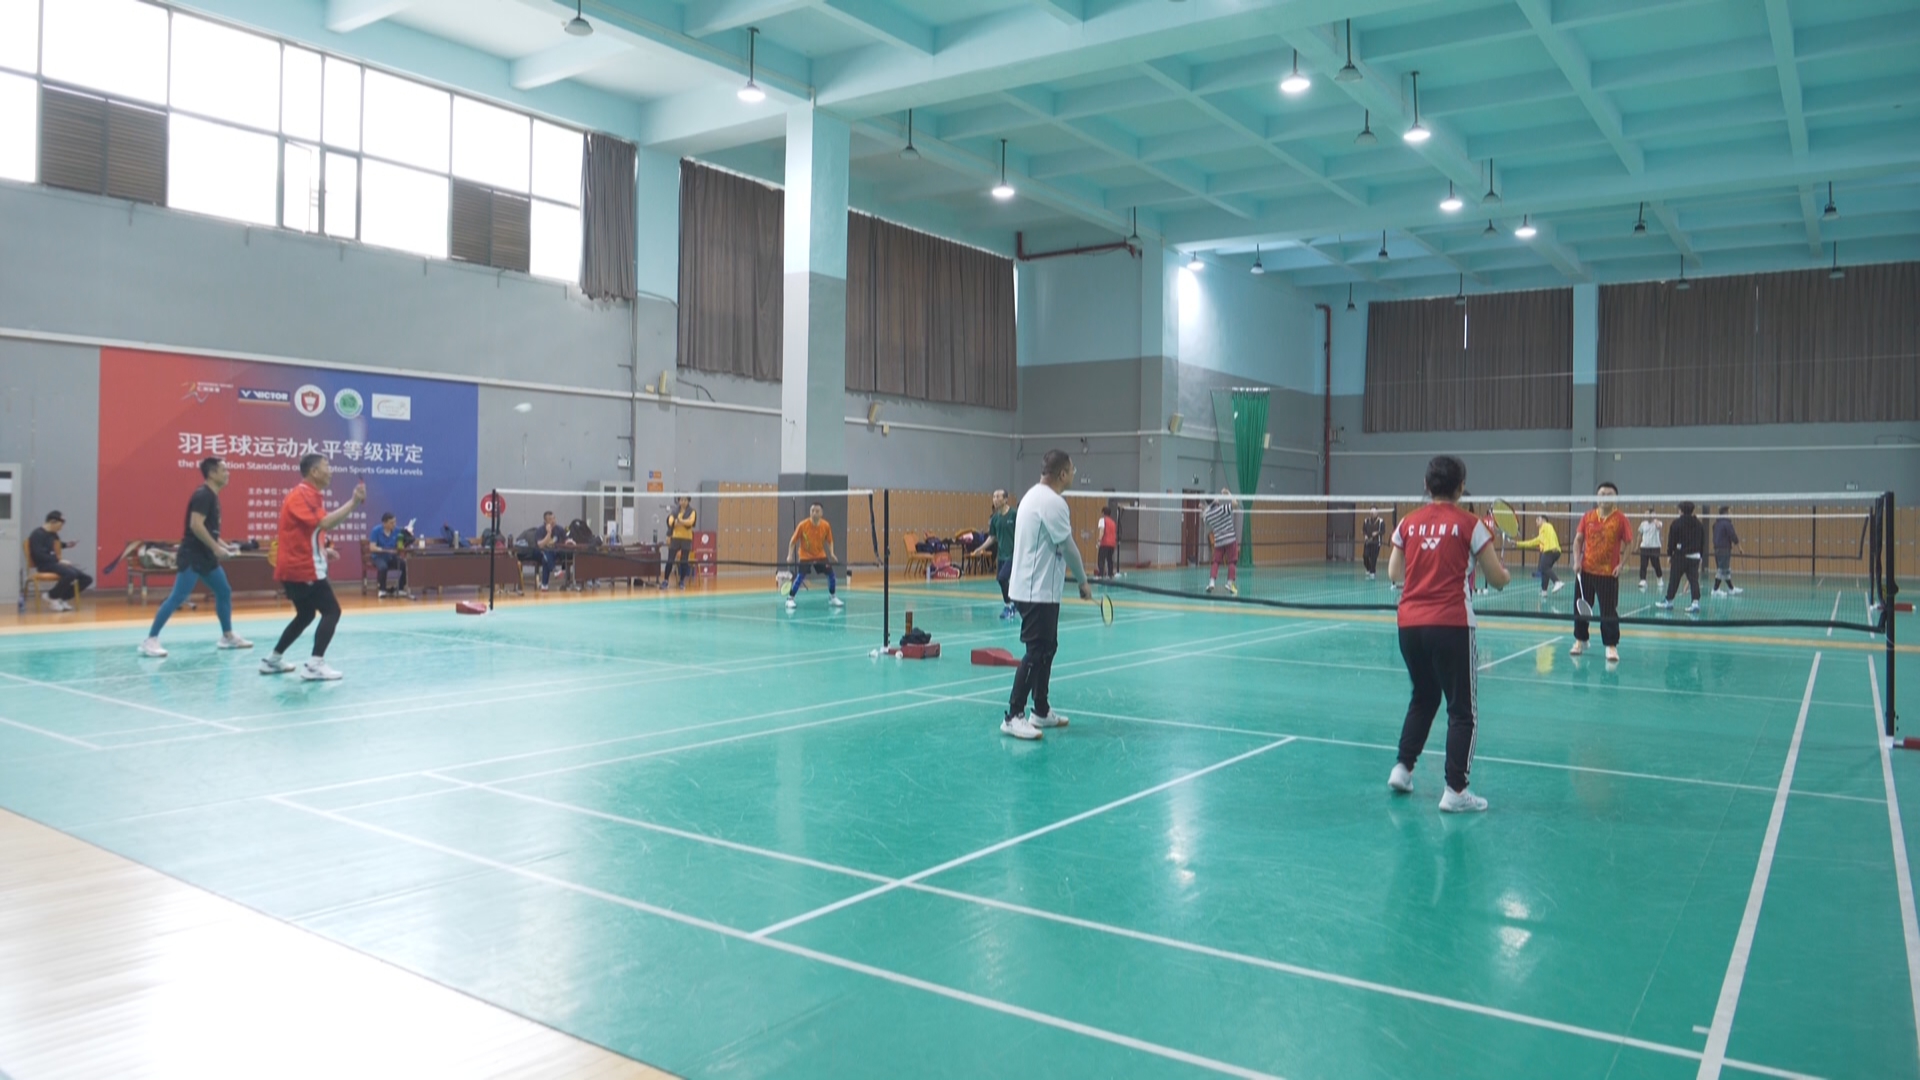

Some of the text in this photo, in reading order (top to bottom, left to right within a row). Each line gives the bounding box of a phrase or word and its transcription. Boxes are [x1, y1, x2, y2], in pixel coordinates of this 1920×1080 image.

[253, 390, 288, 401] VICTOR
[178, 432, 423, 464] 羽毛球运动水平等级评定
[178, 459, 194, 468] the
[196, 459, 245, 470] Etion
[246, 461, 290, 471] Standards
[349, 465, 375, 475] Sports
[376, 466, 399, 475] Grade
[400, 467, 423, 476] Levels
[1408, 523, 1458, 536] CHINA
